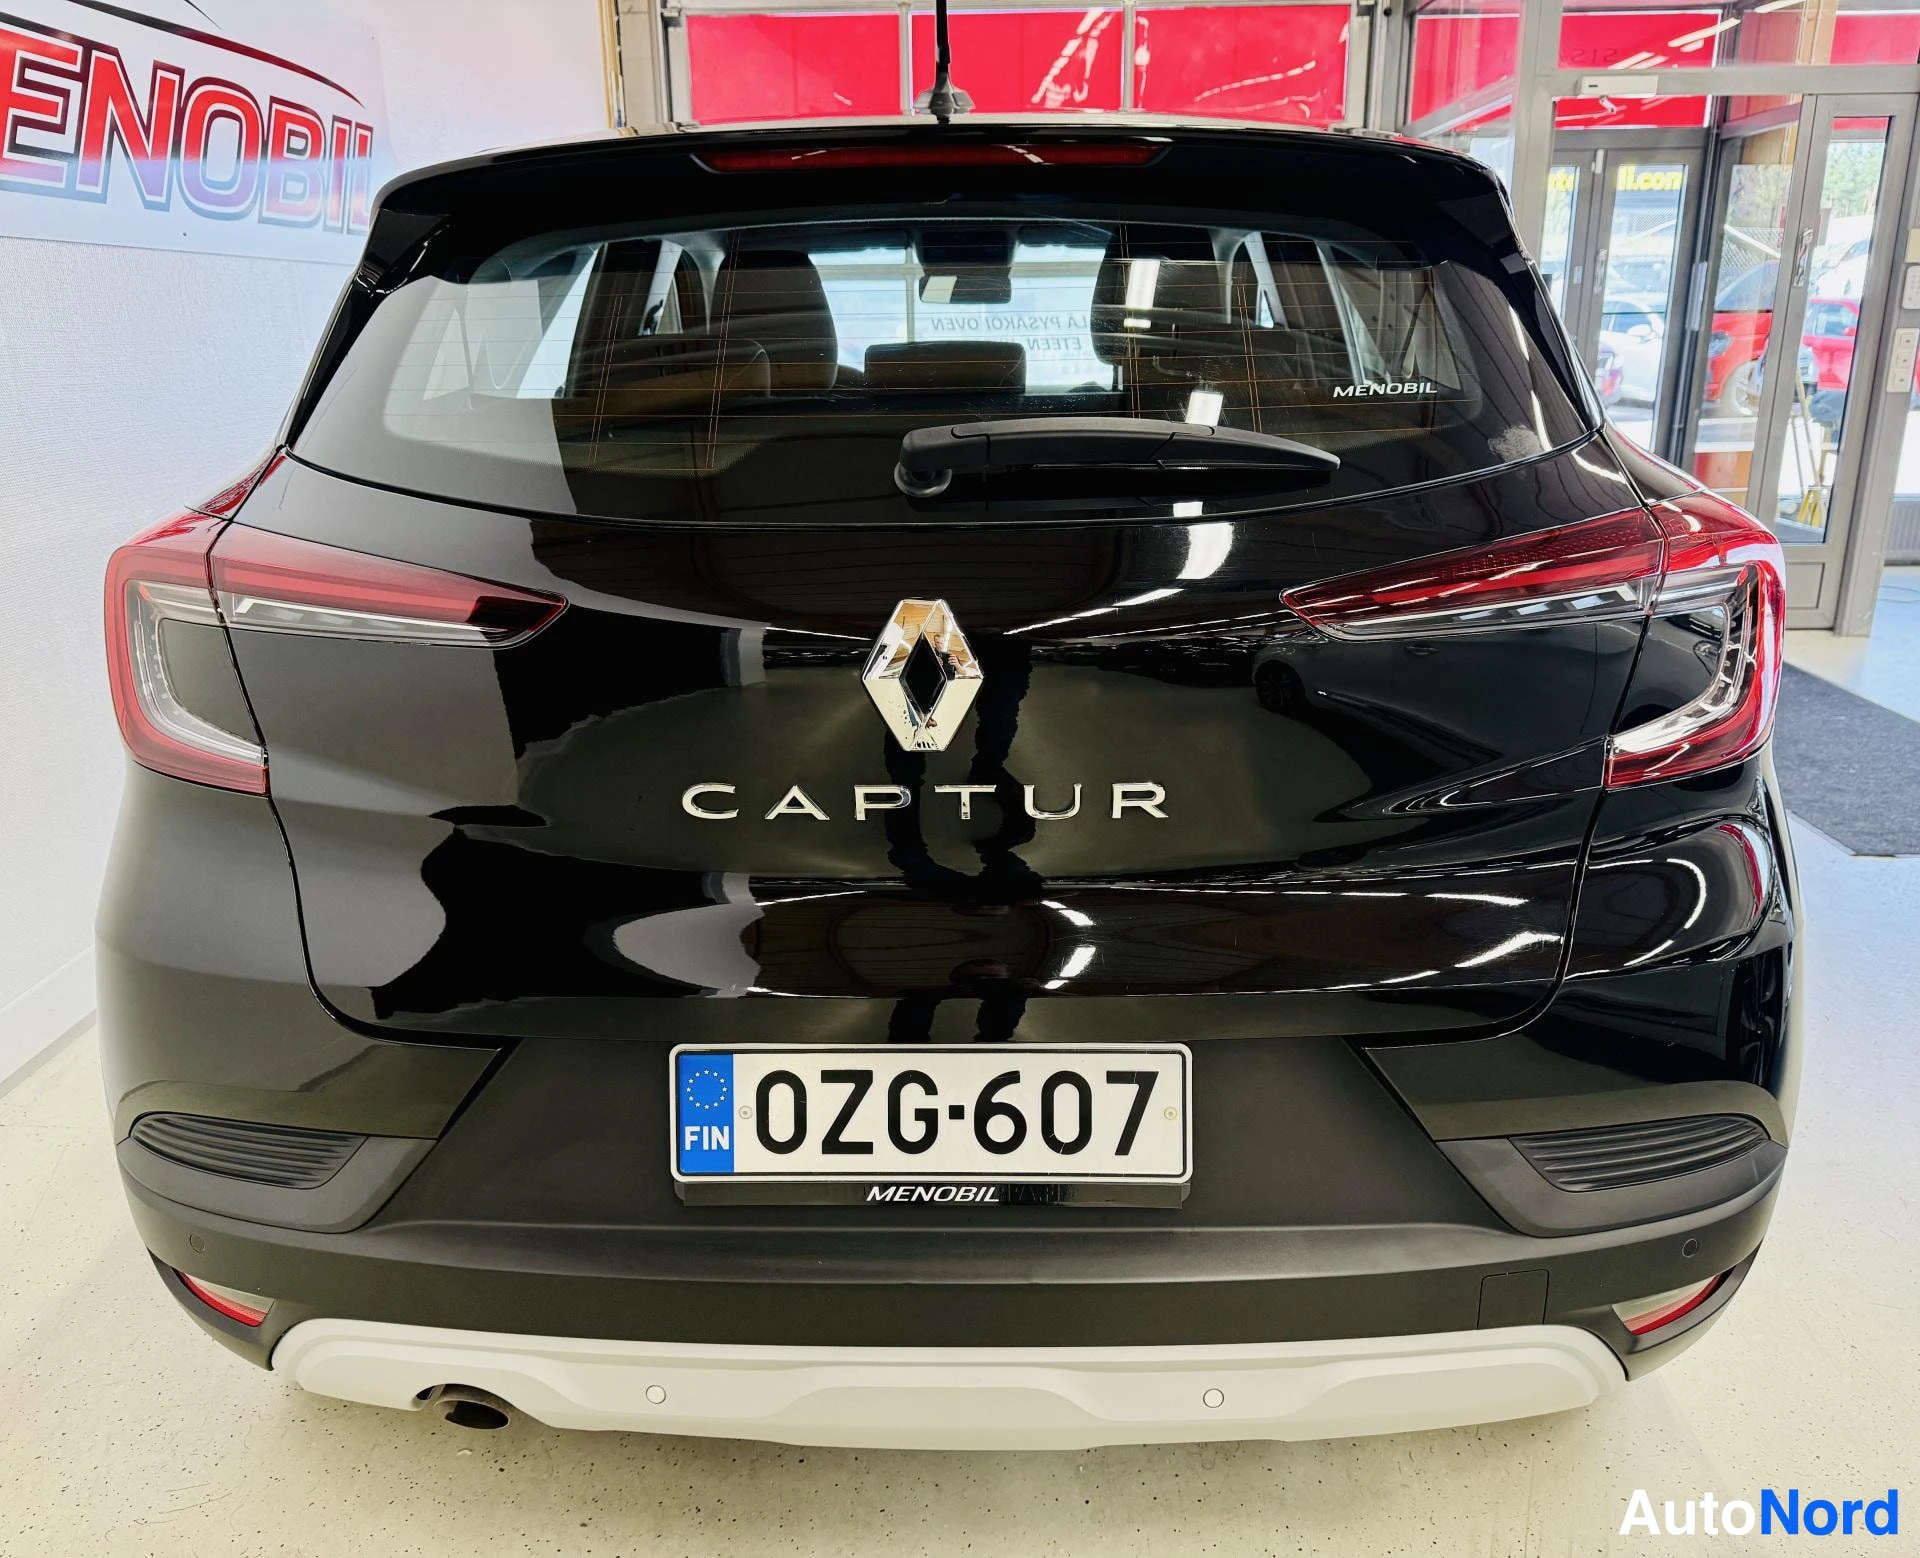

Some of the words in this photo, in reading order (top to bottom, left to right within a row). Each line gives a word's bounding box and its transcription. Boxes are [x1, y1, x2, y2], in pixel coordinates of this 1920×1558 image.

[0, 14, 374, 236] ENOBIL
[1333, 382, 1438, 398] MENOBIL
[681, 782, 1169, 821] CAPTUR
[755, 1069, 1159, 1156] OZG-607
[684, 1125, 730, 1152] FIN
[865, 1185, 1000, 1203] MENOBIL
